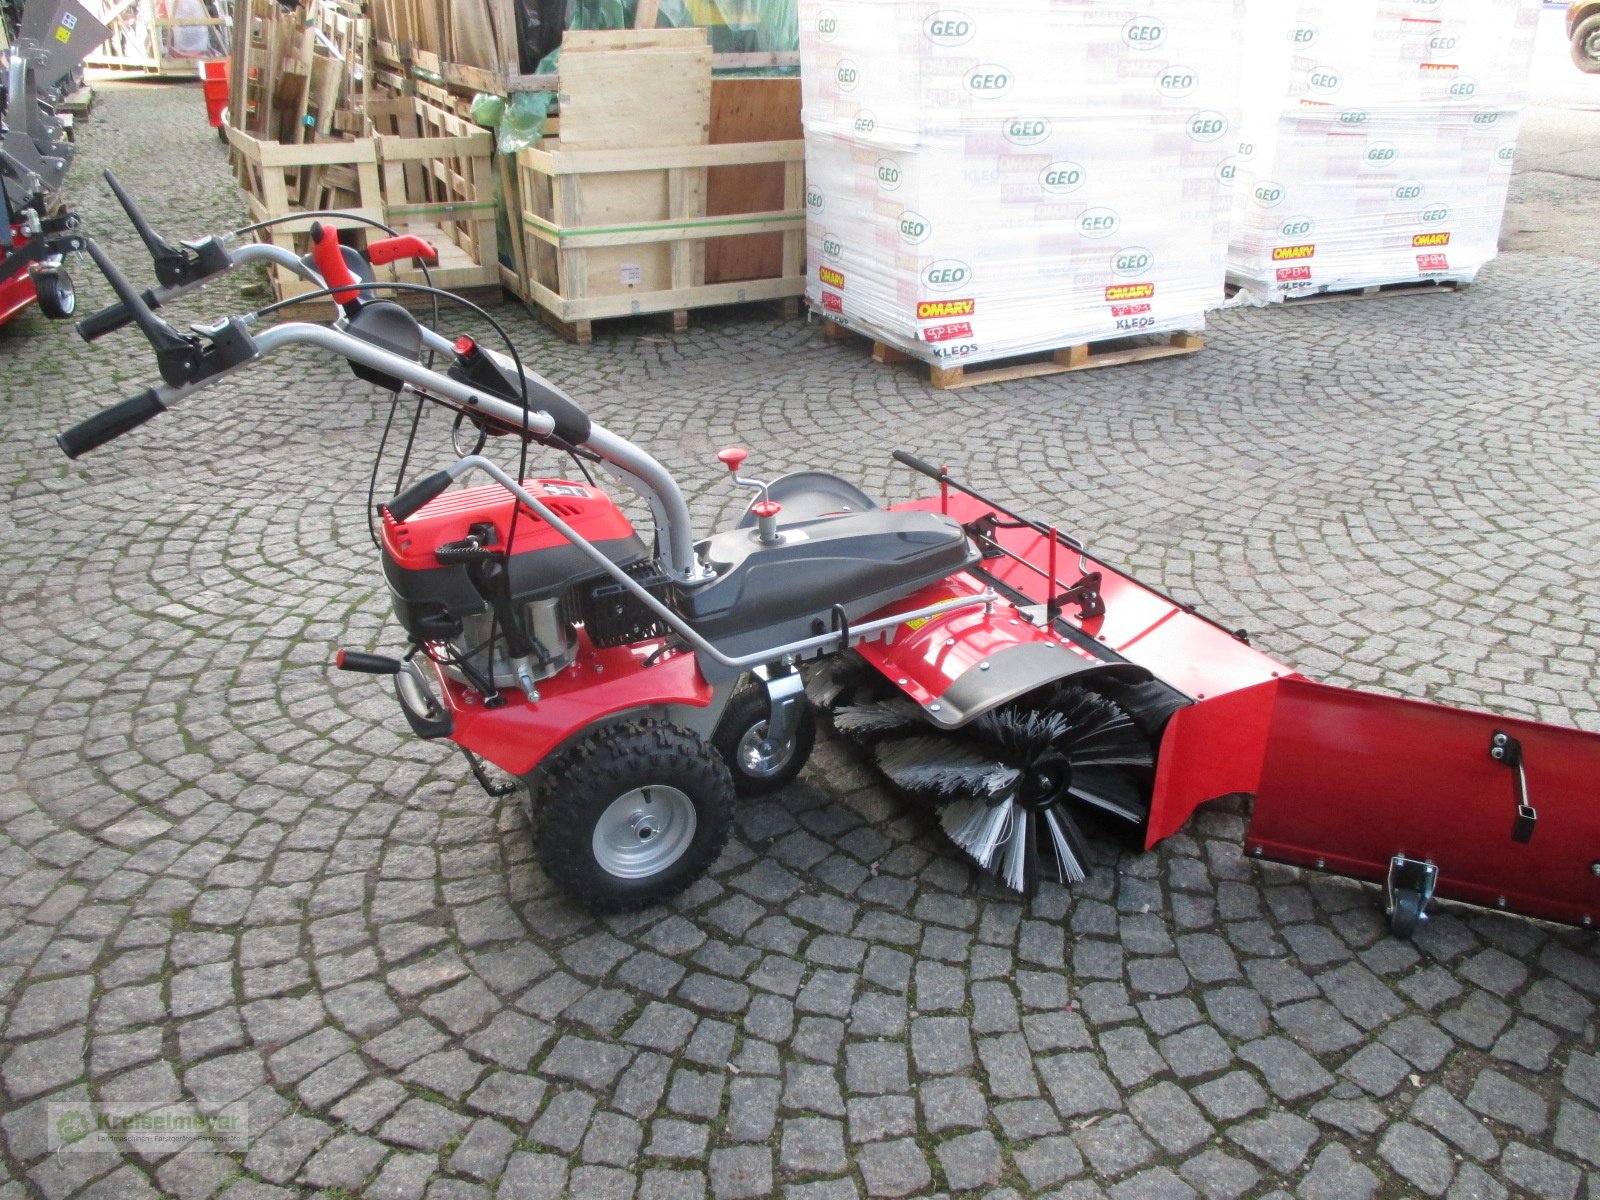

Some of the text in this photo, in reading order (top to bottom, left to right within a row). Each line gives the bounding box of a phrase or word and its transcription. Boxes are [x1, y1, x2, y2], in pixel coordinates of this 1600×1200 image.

[818, 19, 836, 34] GEO
[930, 20, 969, 37] GEO
[1128, 25, 1161, 41] GEO
[1430, 37, 1456, 49] GEO
[838, 68, 856, 83] GEO
[969, 74, 1008, 90] GEO
[1160, 74, 1193, 89] GEO
[1310, 73, 1338, 88] GEO
[1449, 83, 1475, 96] GEO
[854, 118, 874, 132] GEO
[1473, 113, 1498, 124] GEO
[1009, 120, 1045, 136] GEO
[1191, 119, 1222, 134] GEO
[1237, 142, 1253, 155] EO
[1368, 148, 1395, 160] GEO
[878, 166, 898, 183] GEO
[1045, 170, 1080, 185] GEO
[807, 192, 823, 208] GEO
[1255, 187, 1280, 201] GEO
[1395, 186, 1420, 199] GEO
[1422, 209, 1448, 221] GEO
[900, 219, 925, 237] GEO
[1081, 216, 1114, 231] GEO
[1282, 222, 1310, 235] GEO
[823, 240, 841, 256] GEO
[1116, 254, 1148, 270] GEO
[928, 268, 965, 284] GEO
[1116, 317, 1155, 329] KLEOS
[933, 343, 978, 358] KLEOS
